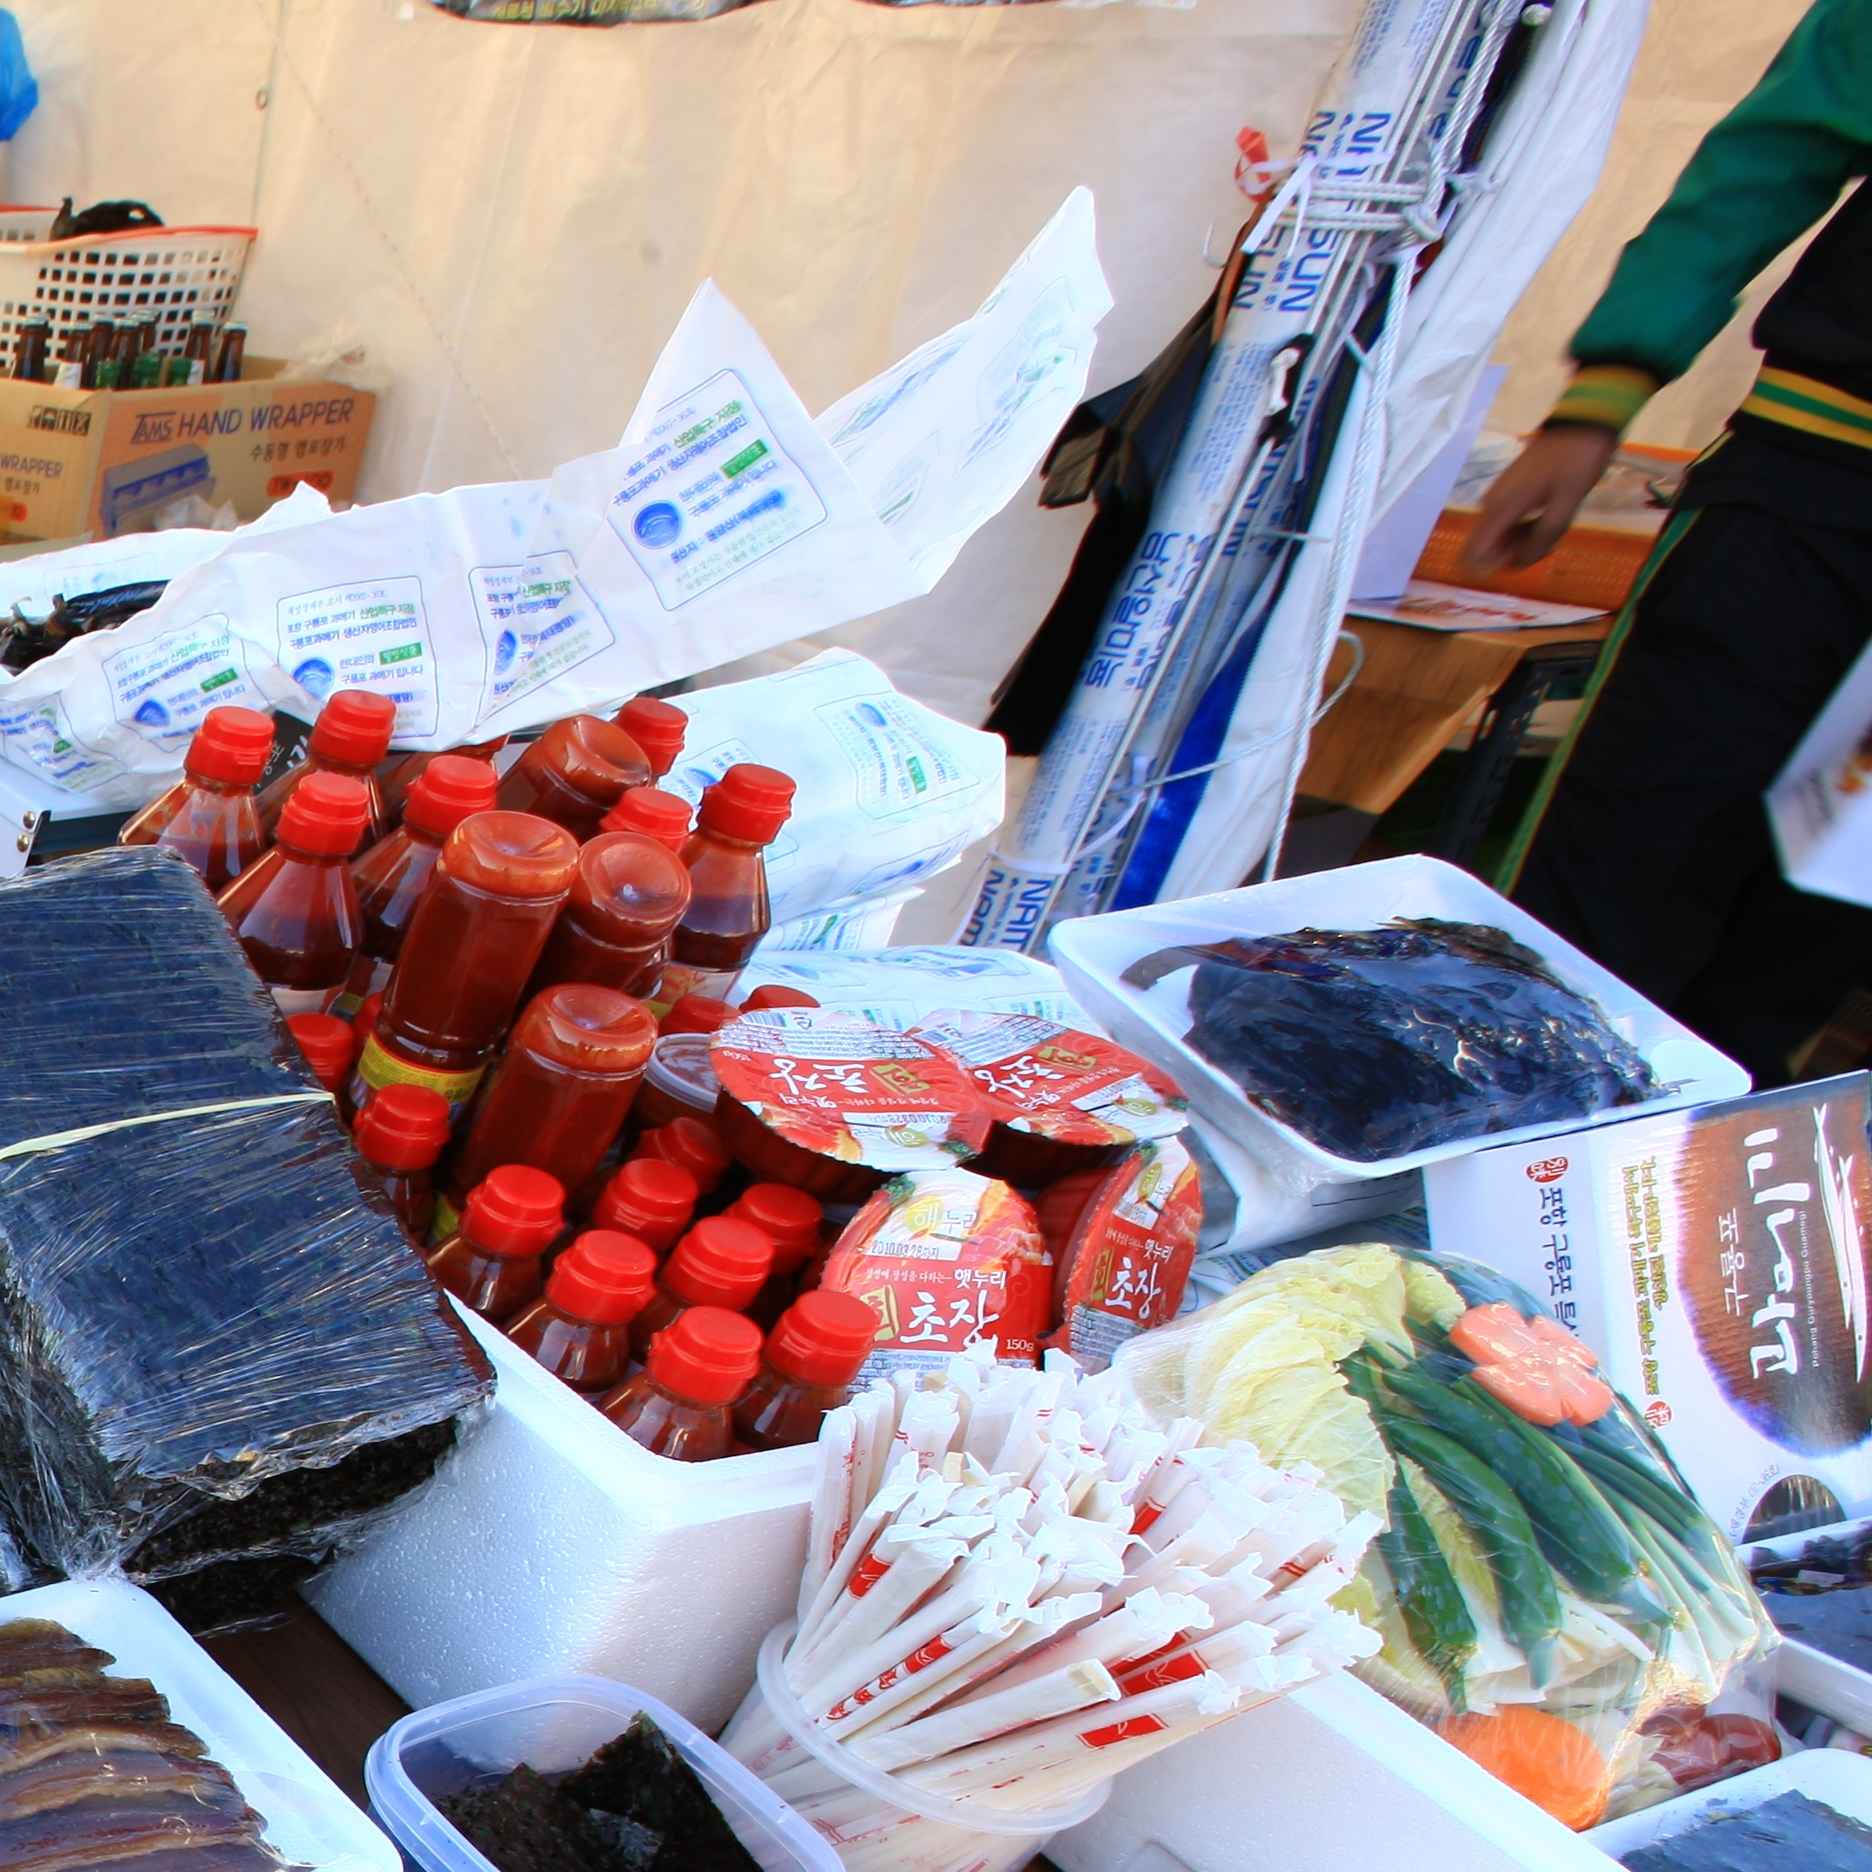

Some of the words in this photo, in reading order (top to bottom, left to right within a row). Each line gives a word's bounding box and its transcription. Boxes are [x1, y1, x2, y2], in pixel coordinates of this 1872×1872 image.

[178, 408, 242, 438] HAND
[250, 398, 356, 431] WRAPPER
[0, 452, 63, 479] WRAPPER
[1537, 1186, 1567, 1228] 포항
[1540, 1233, 1574, 1297] 구룡포
[1716, 1207, 1750, 1317] 구룡포
[1742, 1126, 1811, 1379] 과메기
[899, 1288, 1000, 1347] 초장
[1104, 1256, 1162, 1320] 초장
[1006, 1338, 1035, 1353] 150g
